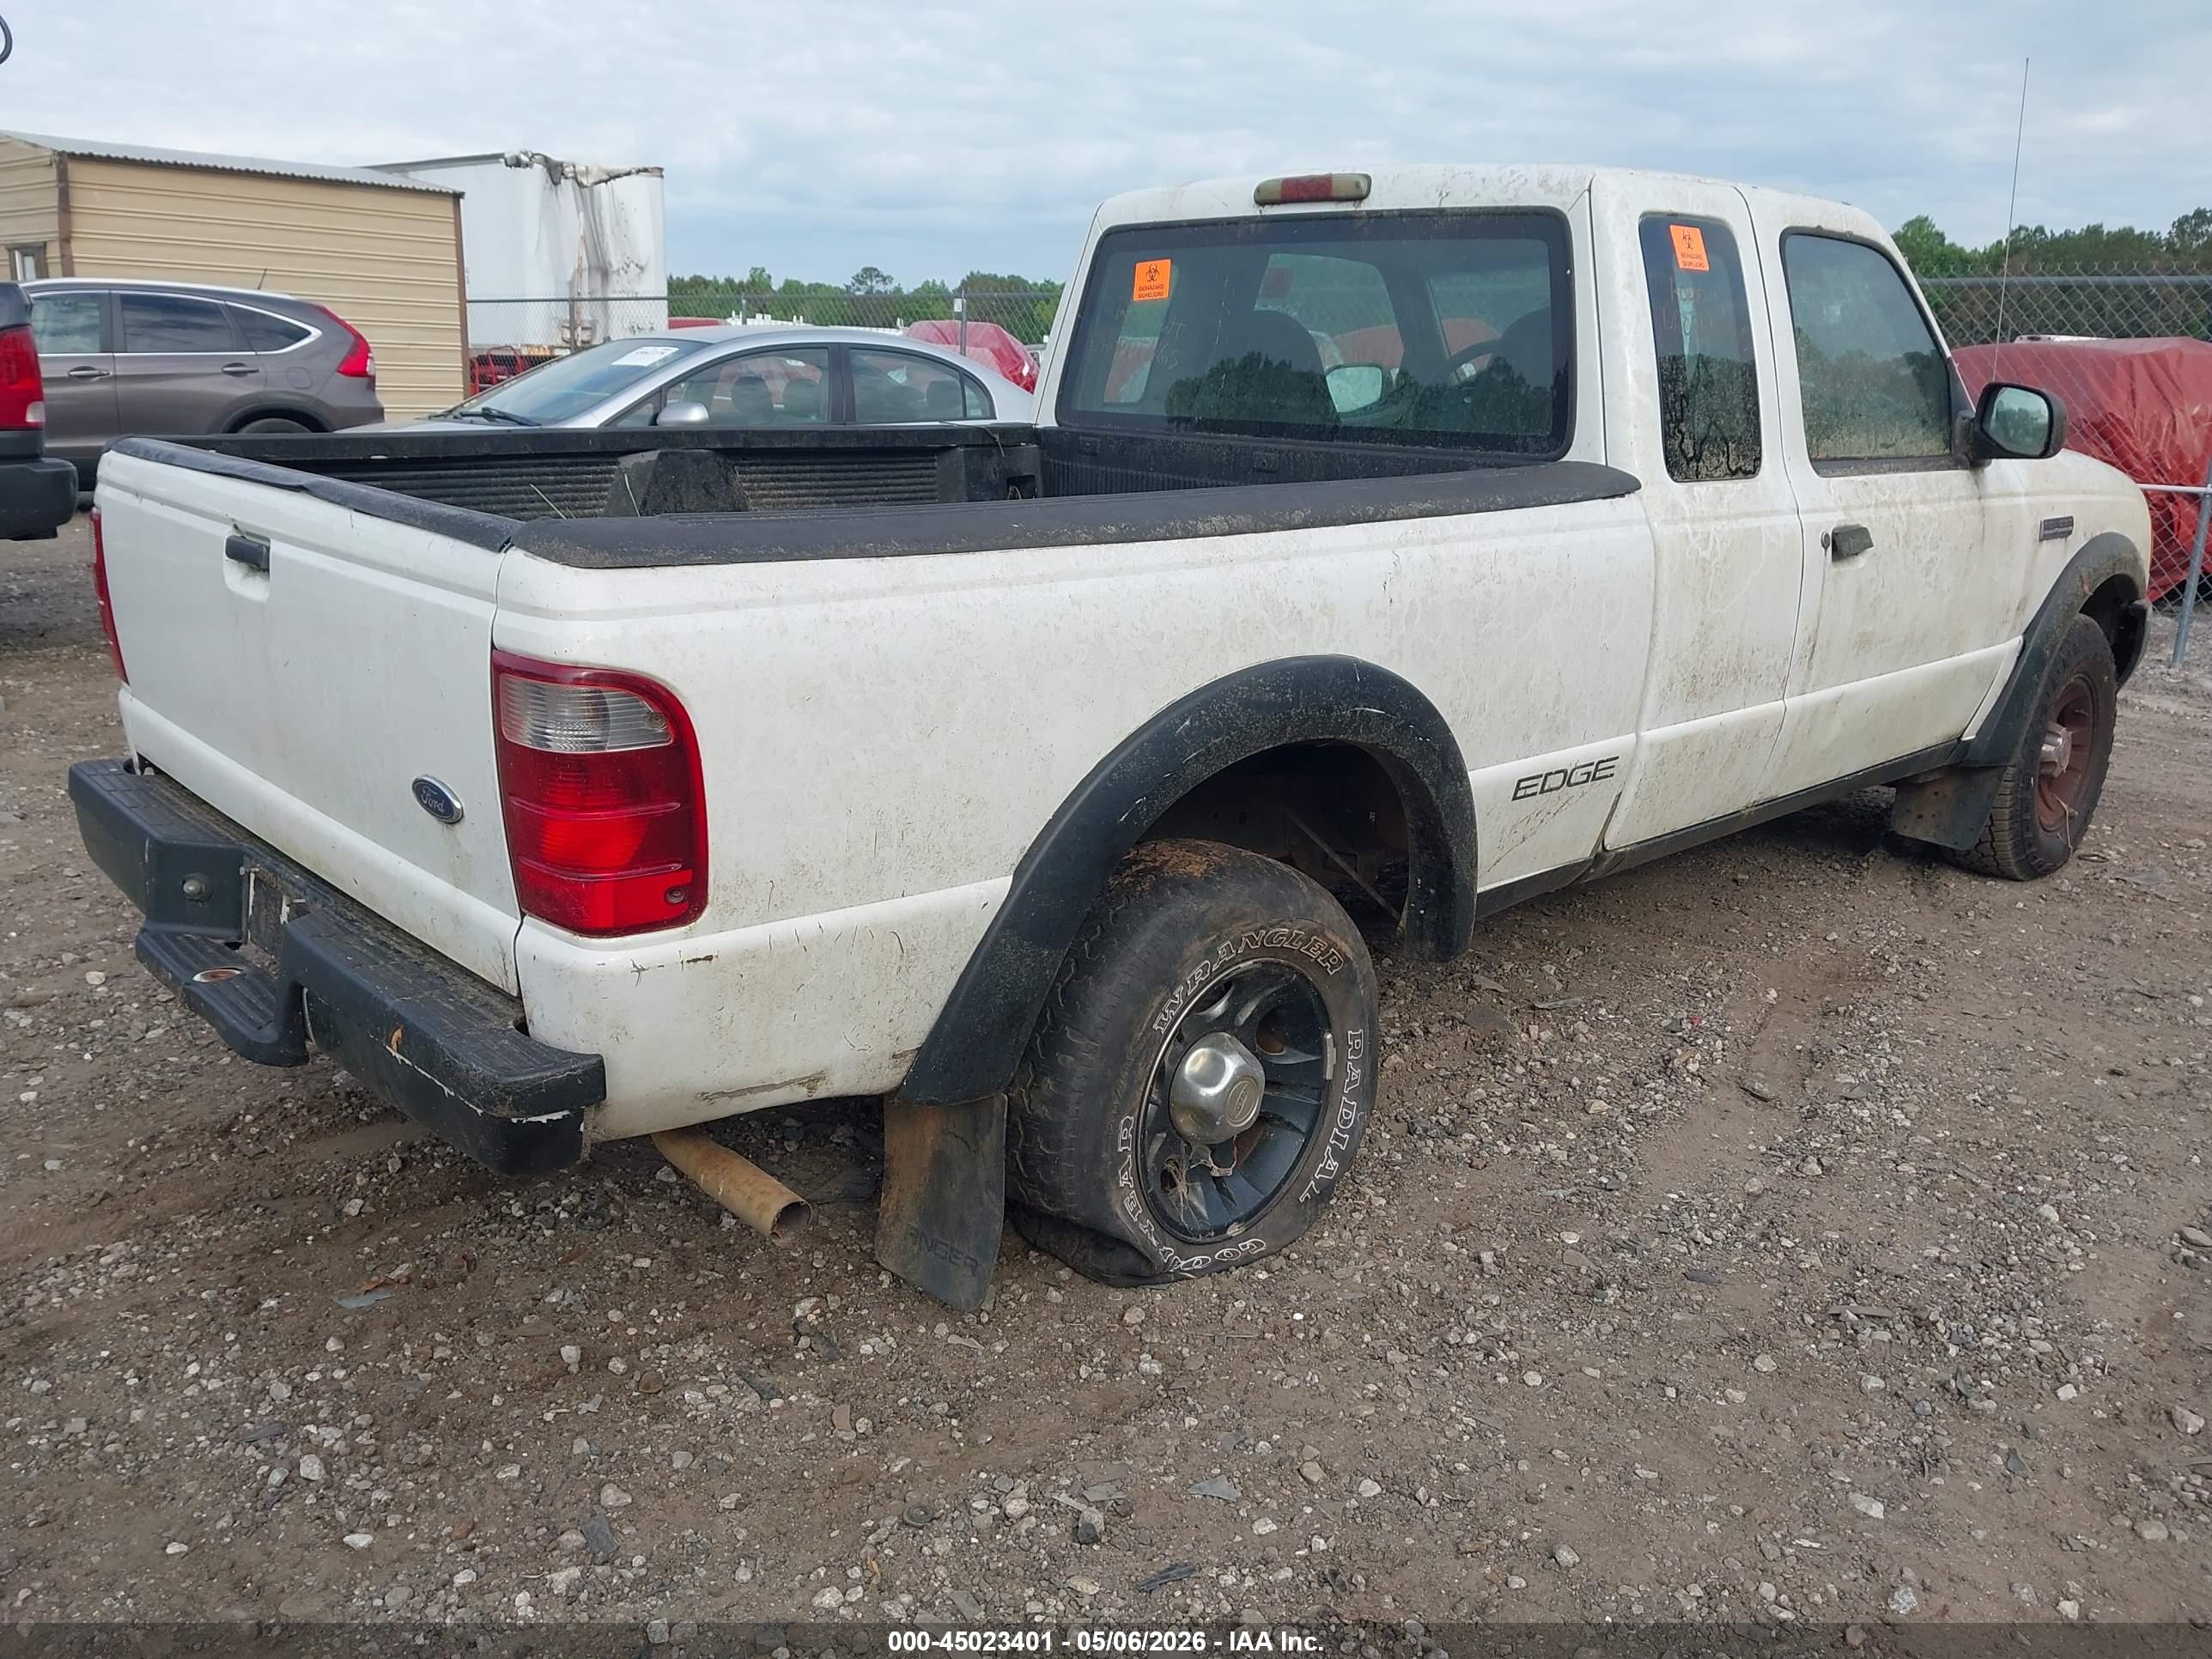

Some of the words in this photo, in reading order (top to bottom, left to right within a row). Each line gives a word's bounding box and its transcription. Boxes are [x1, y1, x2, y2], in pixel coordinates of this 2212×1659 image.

[421, 785, 447, 814] Ford
[1511, 756, 1620, 801] EDGE
[1152, 927, 1345, 1035] WRANGLER
[1298, 1029, 1365, 1203] RADIAL
